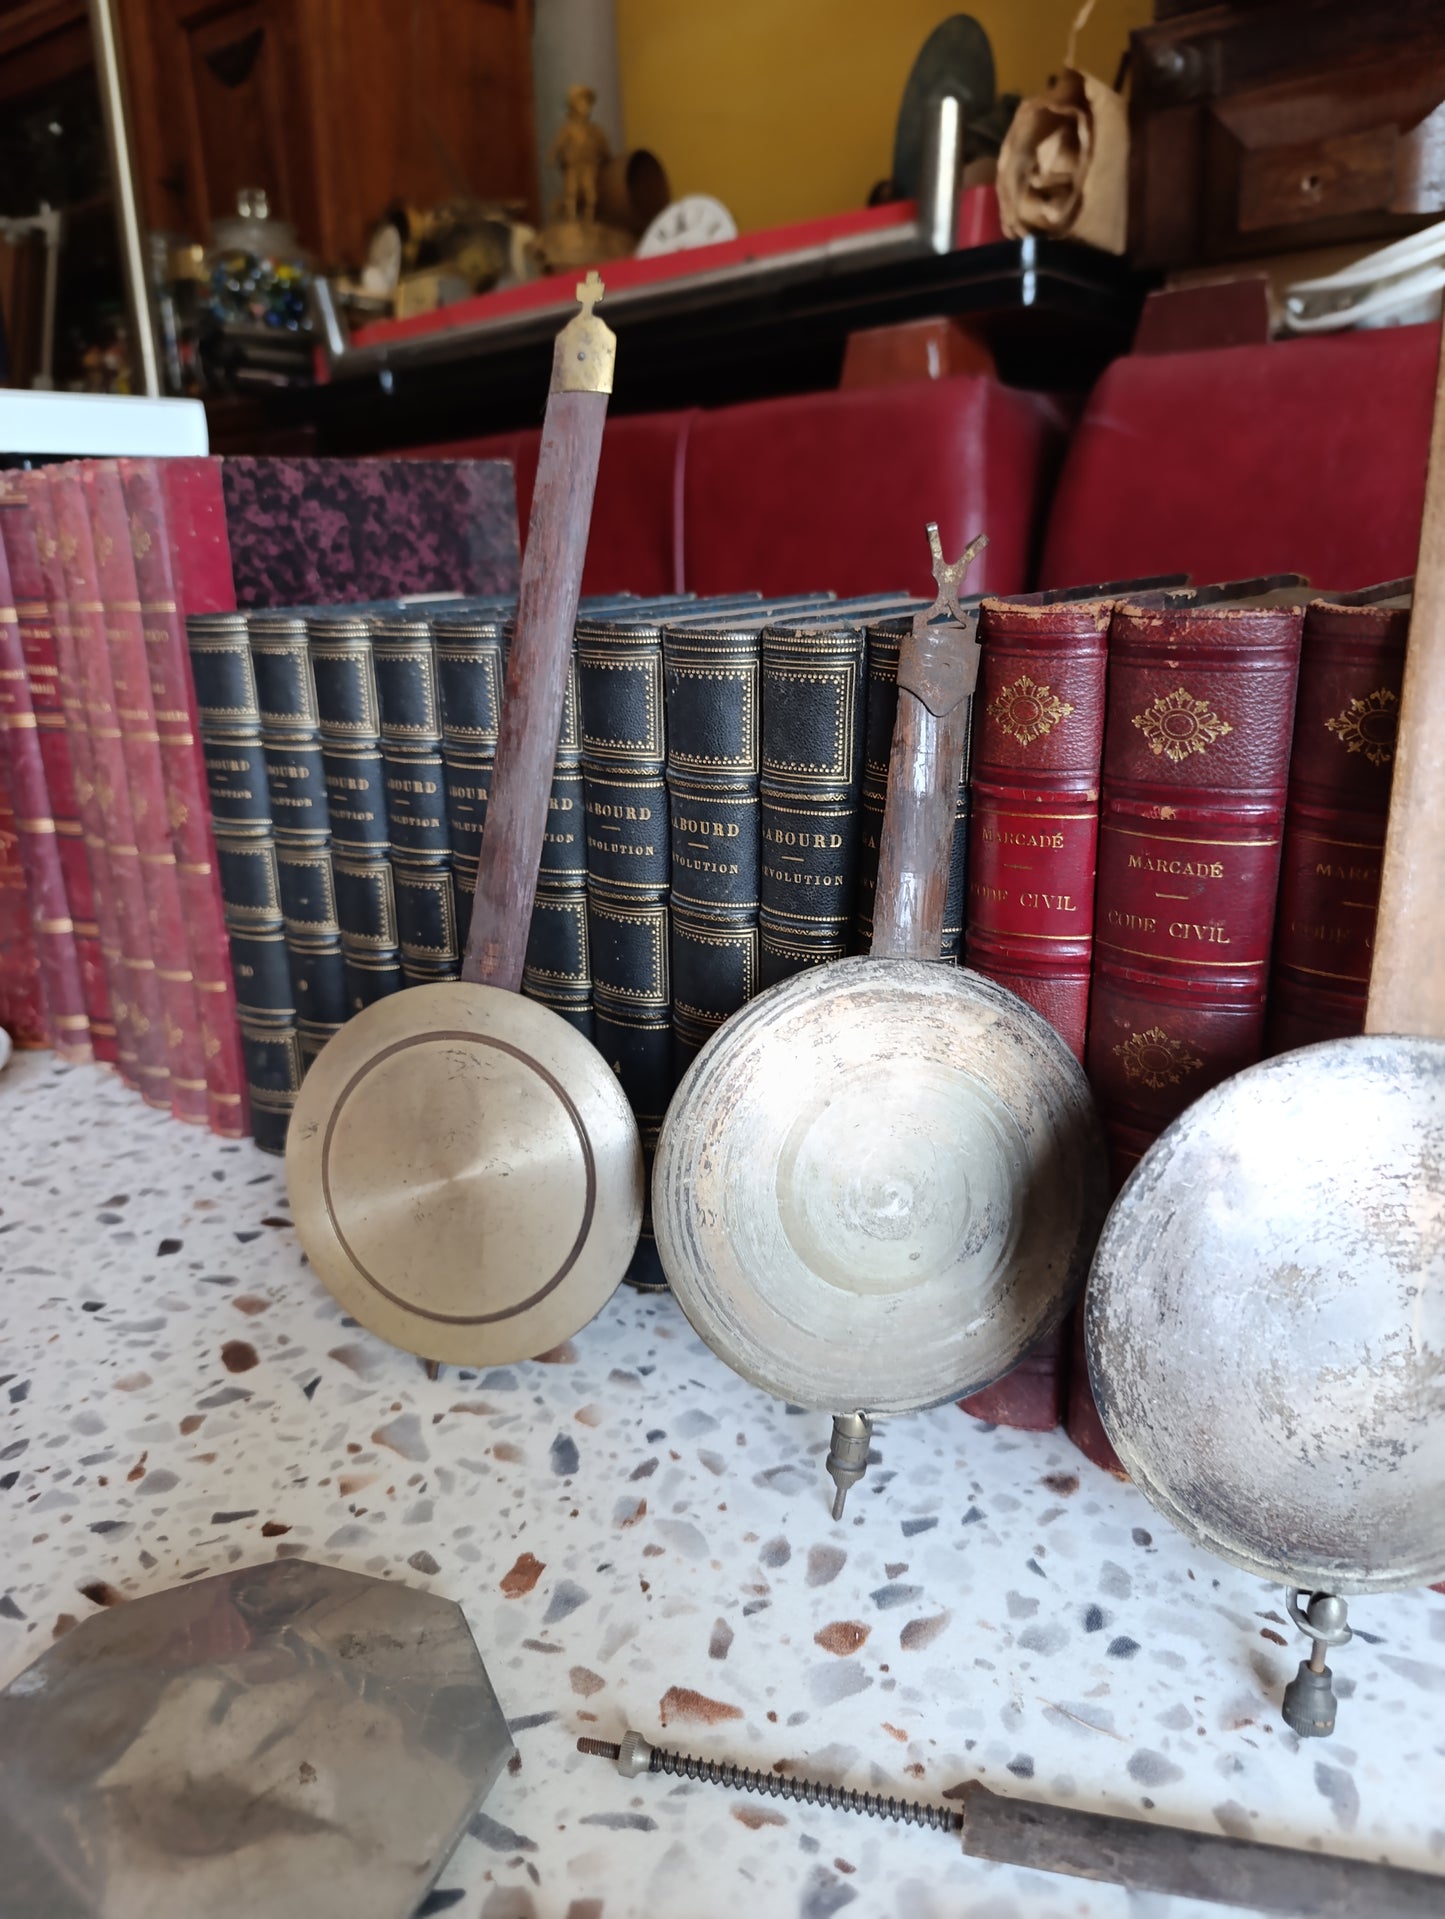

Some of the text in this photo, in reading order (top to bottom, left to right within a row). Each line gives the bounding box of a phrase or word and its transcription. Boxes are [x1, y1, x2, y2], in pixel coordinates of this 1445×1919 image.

[1127, 853, 1225, 879] MARCADÉ
[1020, 893, 1077, 912] CIVIL
[1108, 910, 1231, 944] CODE CIVIL
